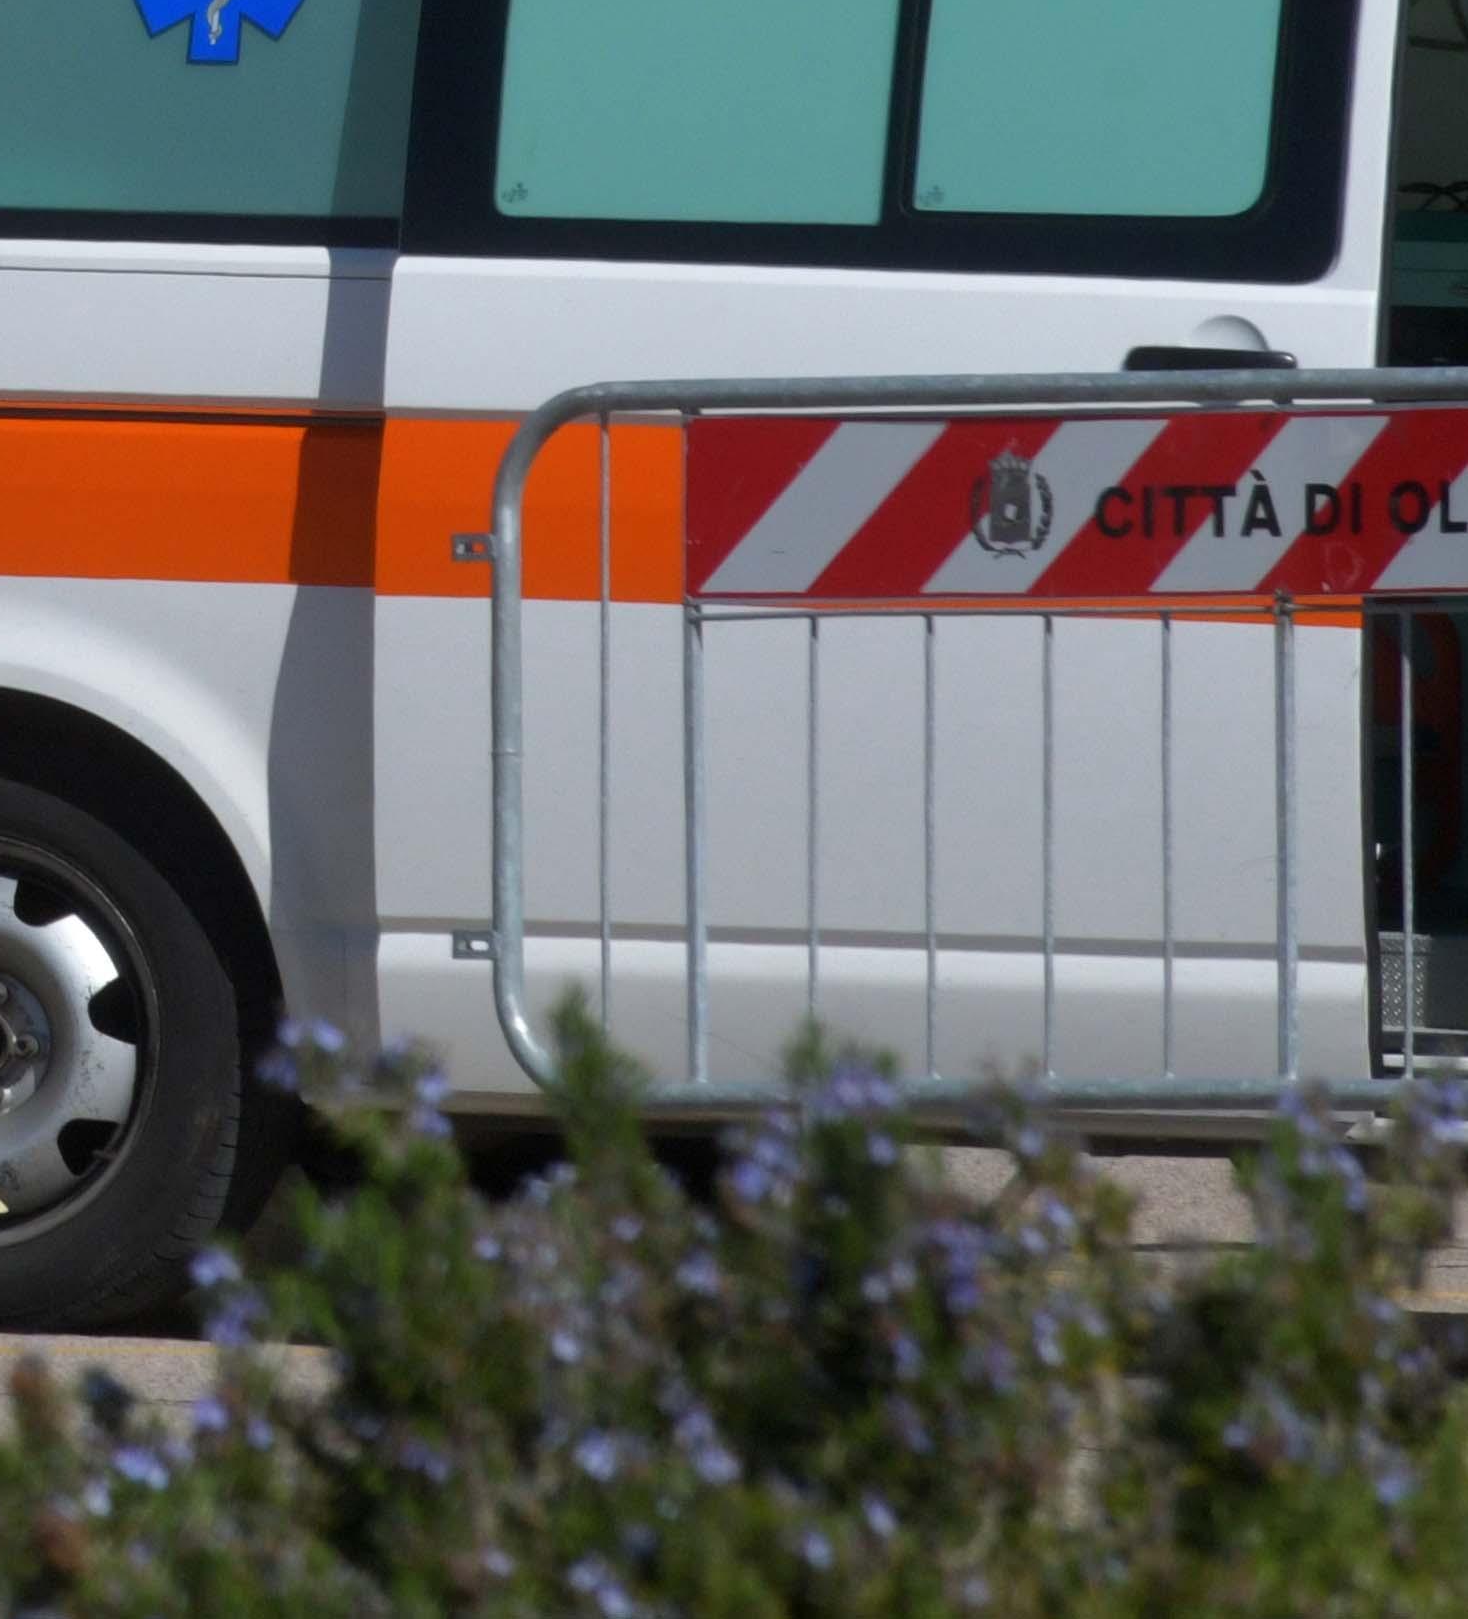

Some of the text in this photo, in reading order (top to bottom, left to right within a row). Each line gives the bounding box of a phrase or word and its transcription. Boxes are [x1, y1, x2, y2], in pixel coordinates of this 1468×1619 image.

[1094, 468, 1468, 539] CITTÀ DI OL
